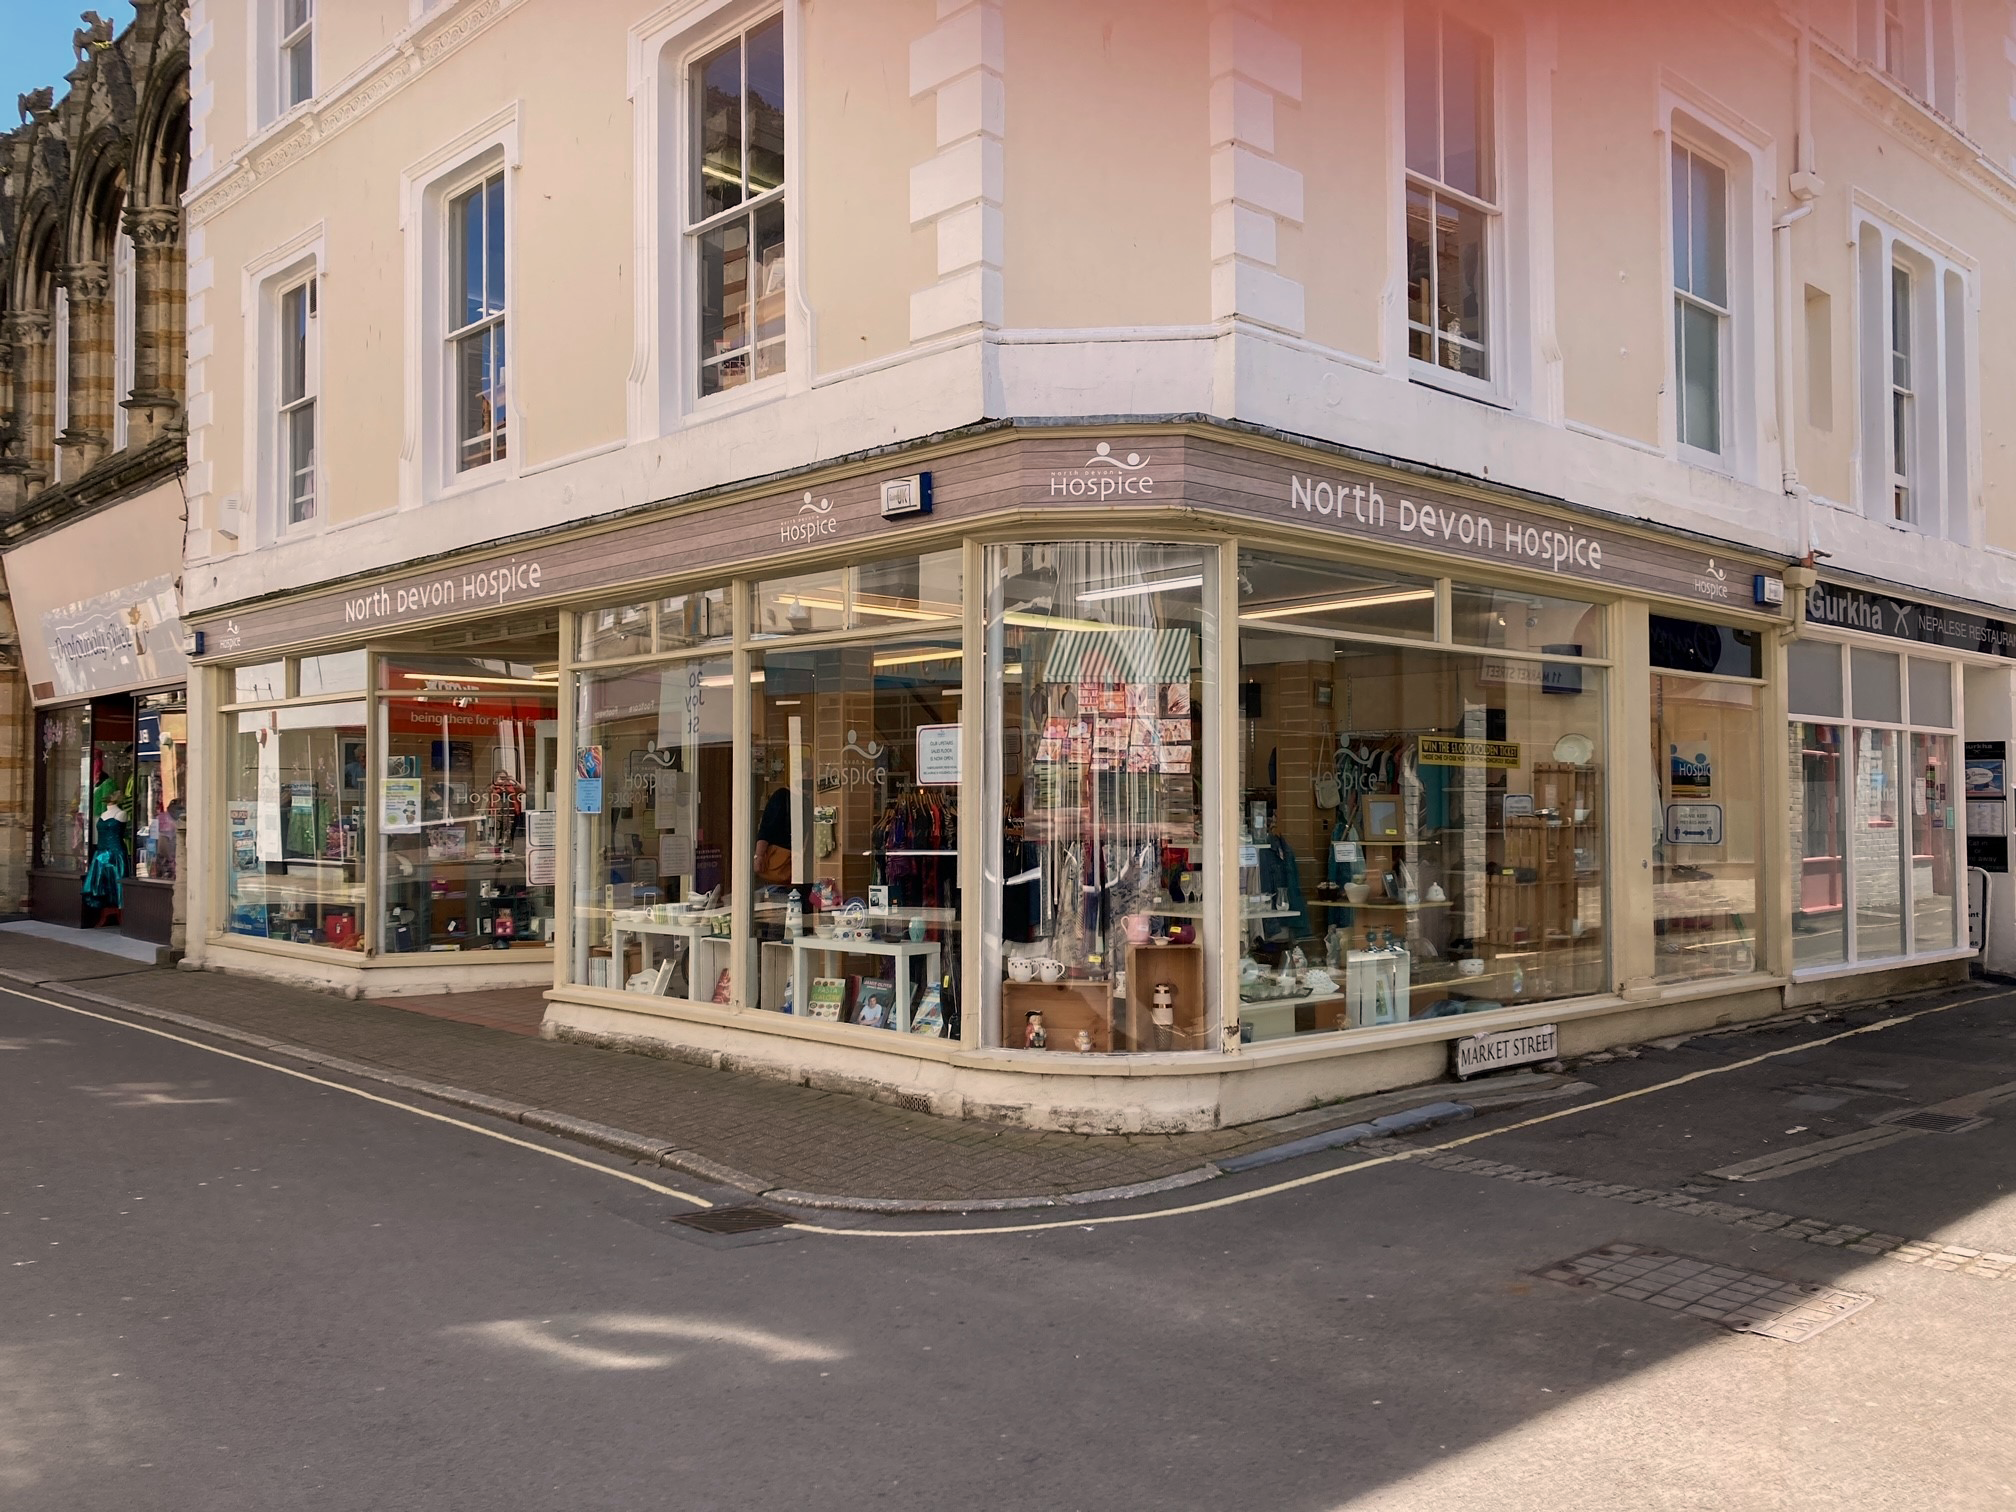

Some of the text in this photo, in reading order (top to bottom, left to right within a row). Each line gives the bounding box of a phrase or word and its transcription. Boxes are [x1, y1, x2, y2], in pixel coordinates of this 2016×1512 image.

[1050, 472, 1154, 502] Hospice
[780, 517, 837, 543] Hospice
[1291, 474, 1602, 572] North Devon Hospice
[345, 558, 542, 623] North Devon Hospice
[1693, 579, 1728, 599] Hospice
[1807, 583, 1883, 630] Gurkha
[1918, 614, 1967, 638] NEPALESE
[219, 636, 241, 652] Hospice
[410, 712, 443, 726] being
[475, 714, 490, 725] for
[1422, 741, 1438, 752] WIN
[1438, 741, 1450, 752] THE
[1473, 743, 1499, 756] GOLDEN
[1499, 746, 1518, 758] TICKET
[1965, 743, 1993, 751] urkha
[818, 765, 886, 792] Hospice
[456, 791, 527, 808] Hospice
[1461, 1032, 1555, 1067] MARKET STREET
